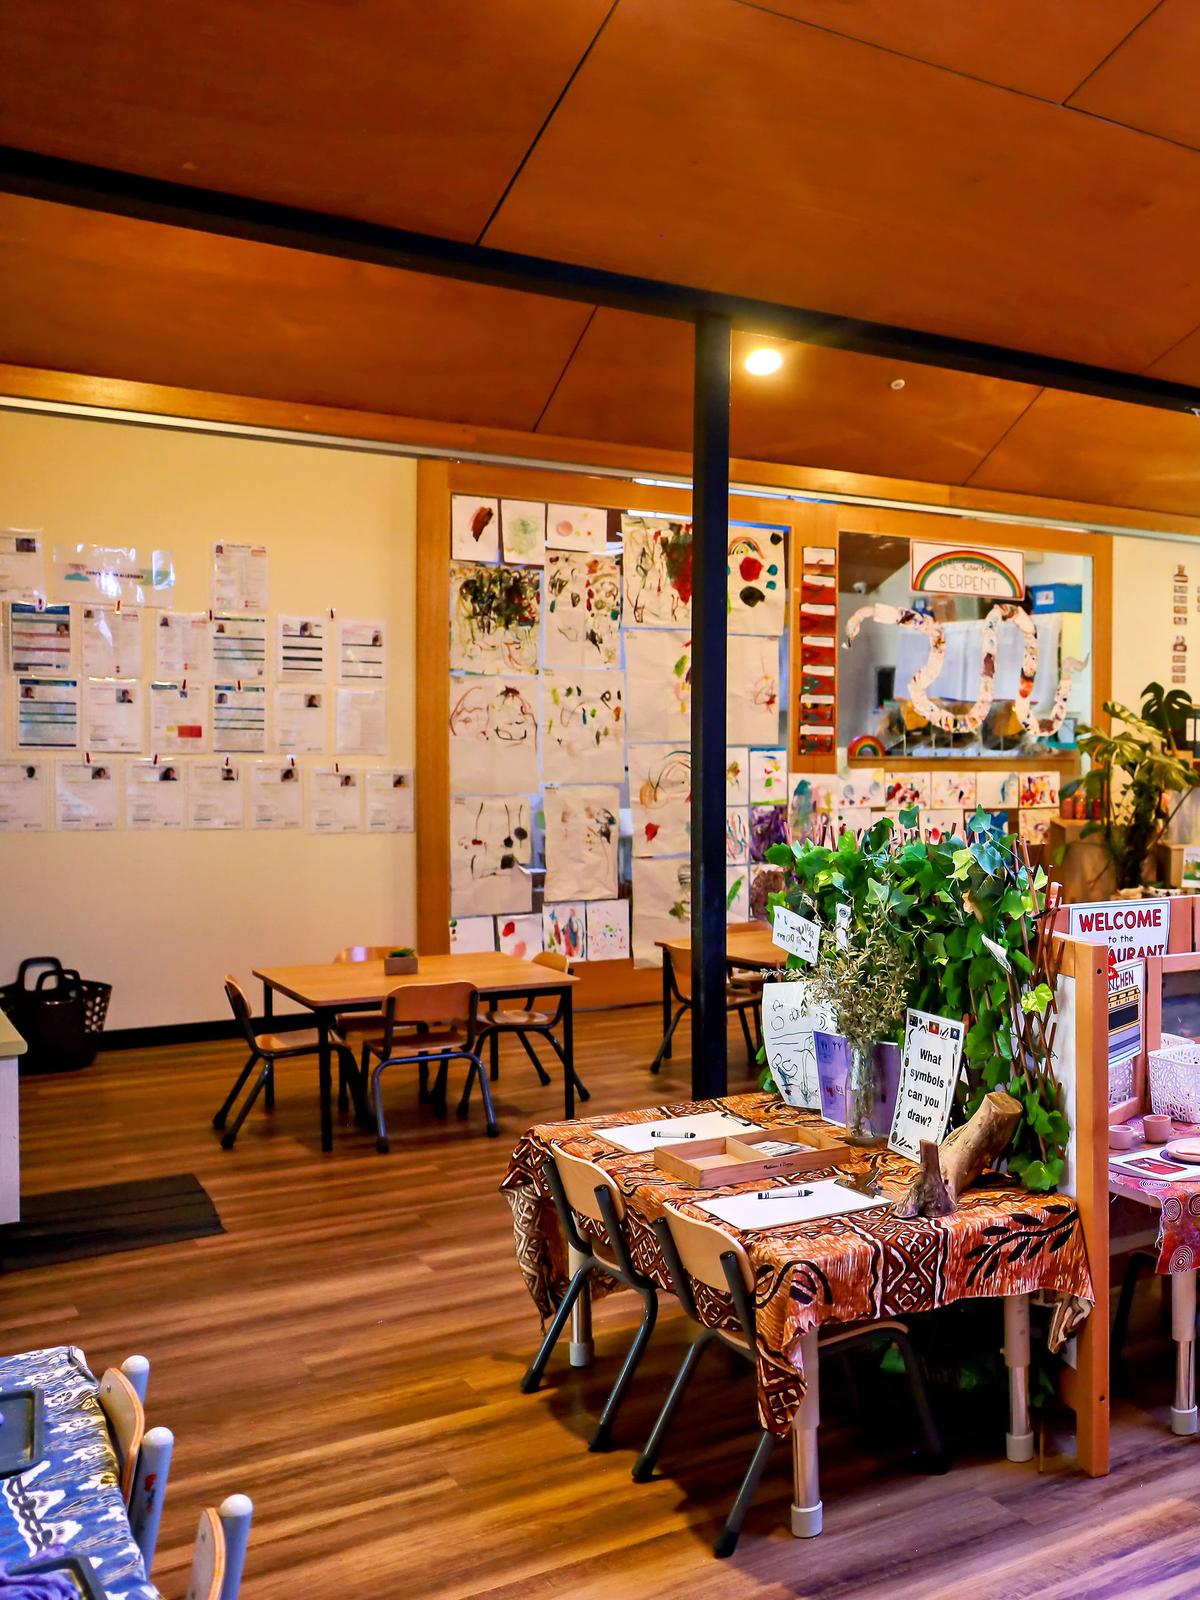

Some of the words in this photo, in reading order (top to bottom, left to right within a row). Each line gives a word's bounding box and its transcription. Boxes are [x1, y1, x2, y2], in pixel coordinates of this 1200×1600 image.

[939, 573, 997, 592] SERPENT
[1079, 909, 1162, 932] WELCOME
[1108, 944, 1165, 964] AURANT
[920, 1048, 941, 1065] What
[910, 1068, 944, 1088] symbols
[907, 1088, 923, 1102] can
[924, 1095, 939, 1108] you
[907, 1108, 932, 1127] draw?
